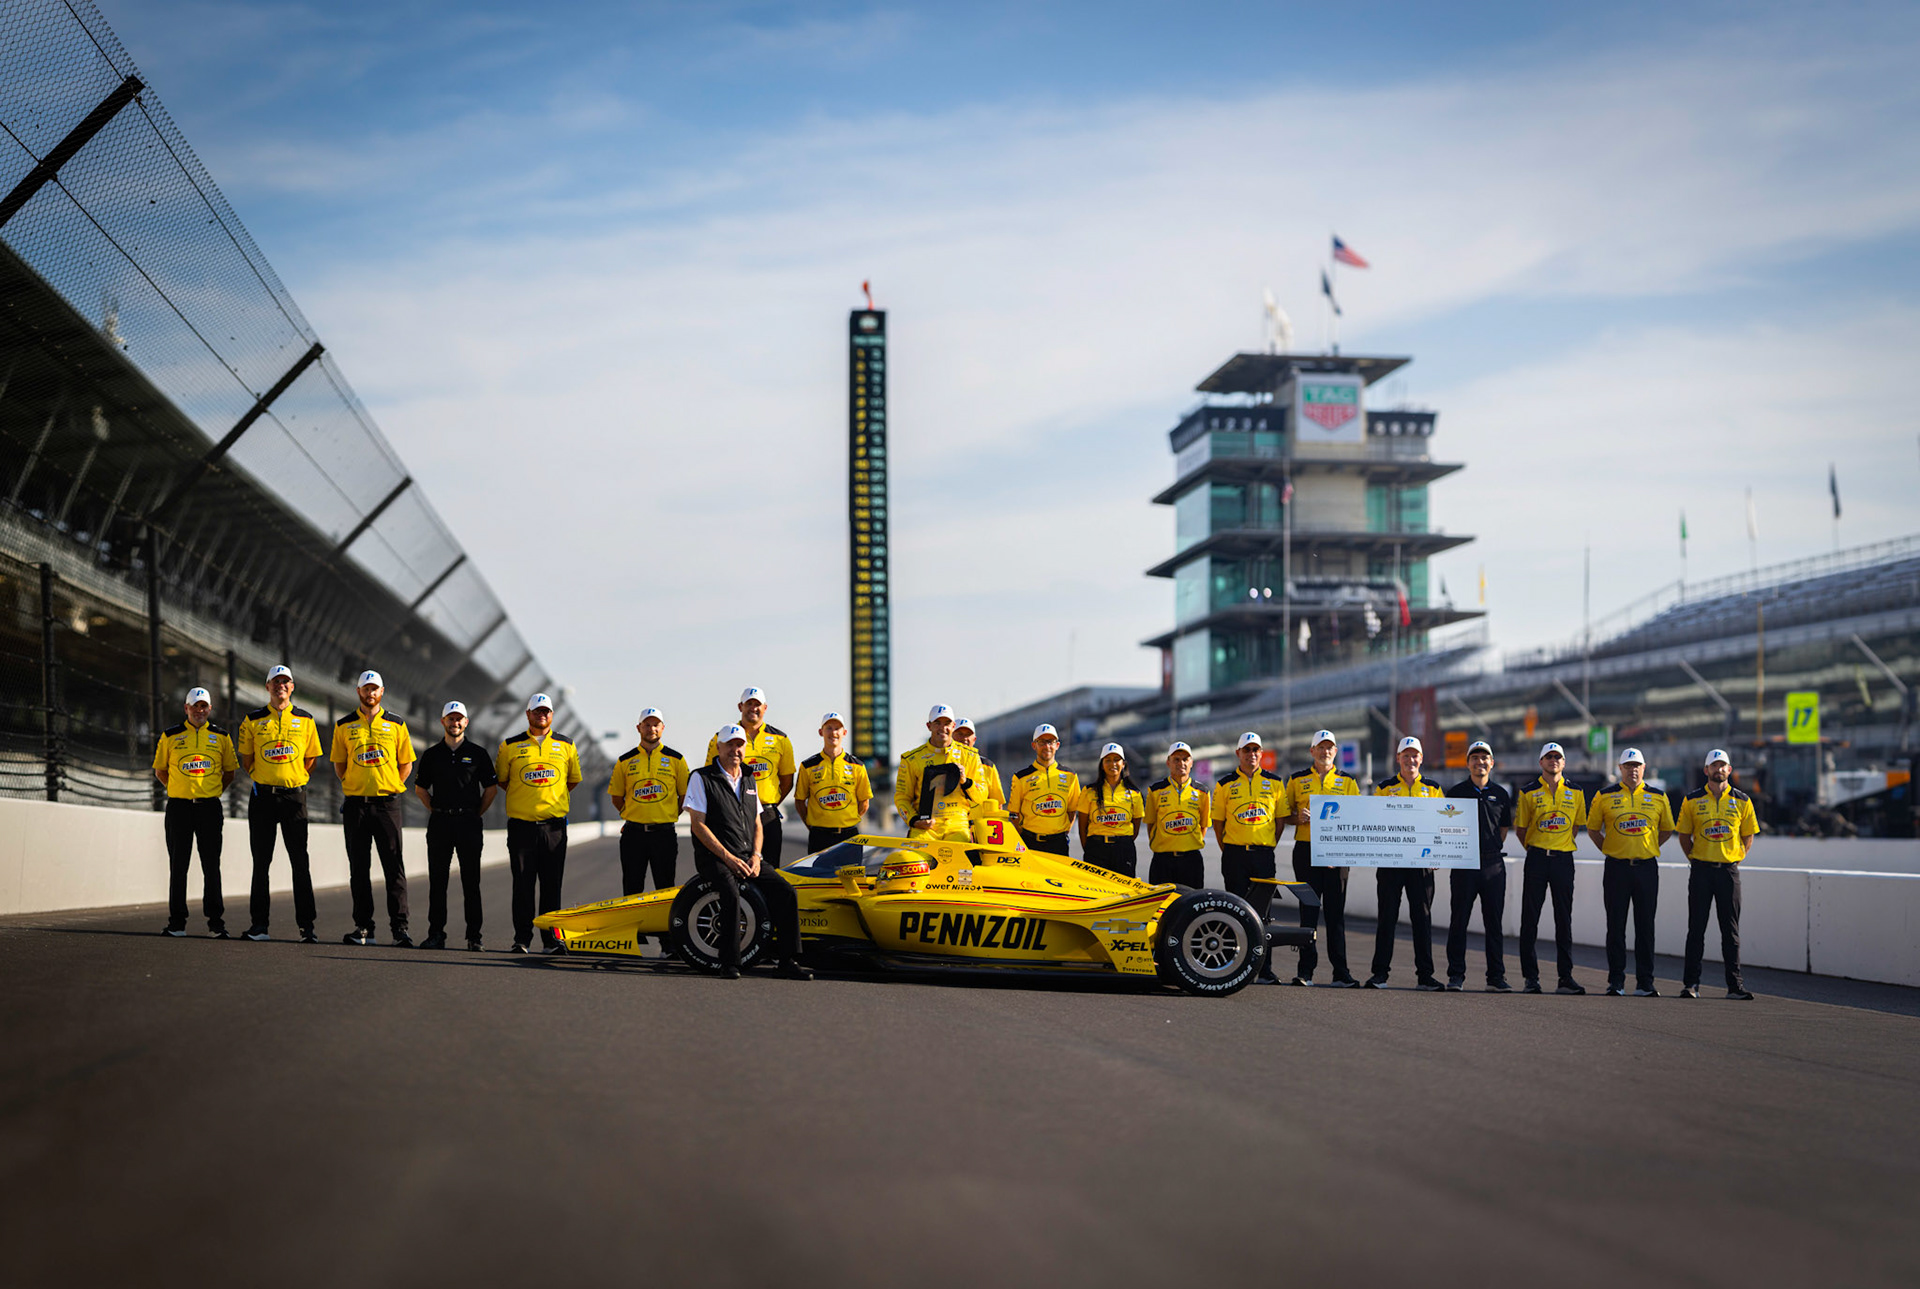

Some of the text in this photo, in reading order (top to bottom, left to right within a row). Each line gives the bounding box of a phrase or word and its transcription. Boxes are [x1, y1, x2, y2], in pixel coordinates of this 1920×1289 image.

[1307, 387, 1353, 402] TAG
[1792, 706, 1814, 728] 17
[524, 769, 556, 780] PENNZOIL
[635, 785, 663, 797] PENNZOIL
[1165, 818, 1193, 829] PENNZOIL
[986, 819, 1004, 845] 3
[997, 856, 1021, 864] DEX
[902, 864, 926, 873] SCOTT
[1070, 860, 1131, 886] PENSKE Truck
[1192, 900, 1246, 917] Firestone
[900, 911, 1048, 951] PENNZOIL
[570, 940, 632, 950] HITACHI
[1110, 939, 1149, 952] XPEL
[1197, 964, 1253, 991] FIREHAWK
